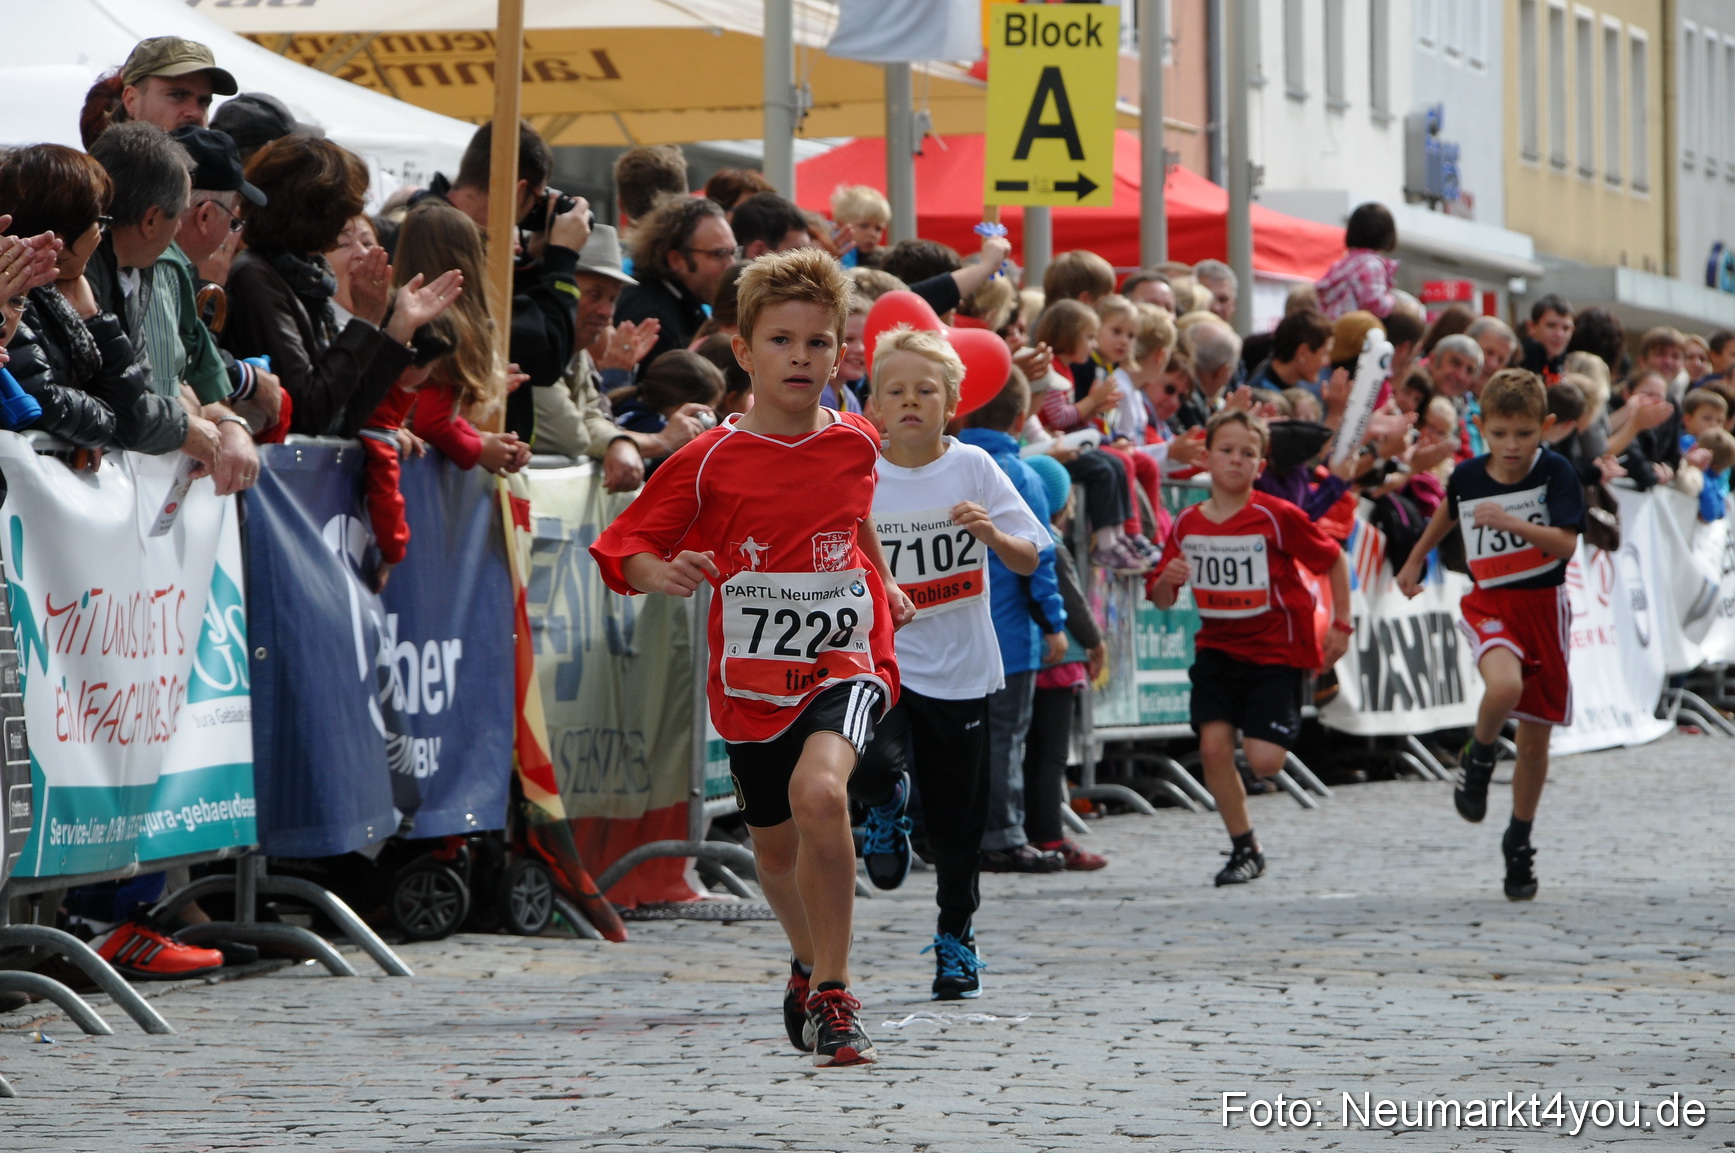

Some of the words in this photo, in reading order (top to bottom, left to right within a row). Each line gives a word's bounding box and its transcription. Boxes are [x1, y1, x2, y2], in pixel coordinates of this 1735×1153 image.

[1004, 12, 1103, 47] Block
[1012, 65, 1086, 161] A
[881, 528, 978, 577] 7102
[1192, 555, 1253, 585] 7091
[725, 584, 777, 600] PARTL
[781, 586, 846, 602] Neumarkt
[907, 581, 960, 605] Tobias
[741, 606, 859, 659] 7228
